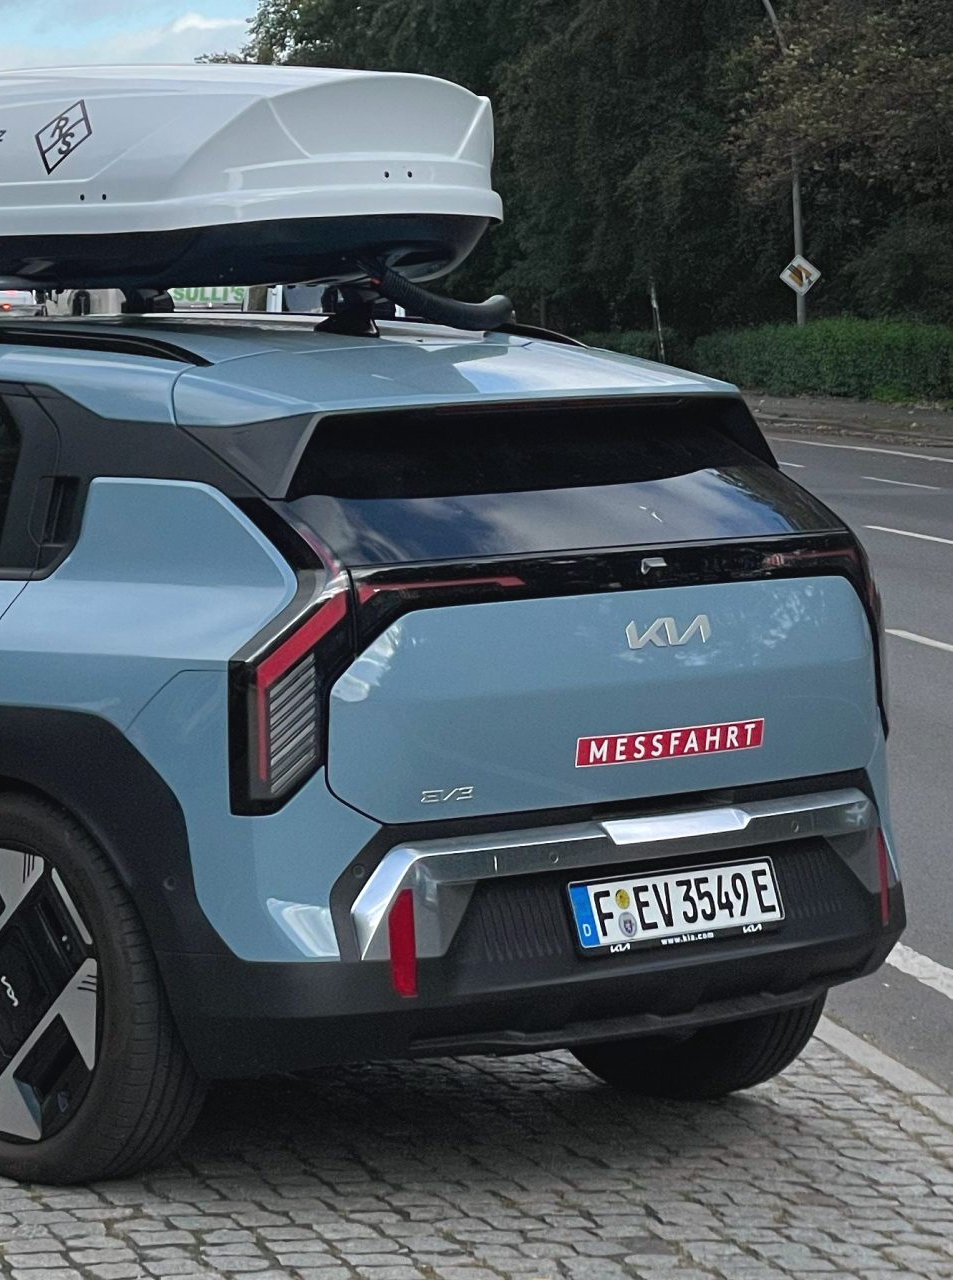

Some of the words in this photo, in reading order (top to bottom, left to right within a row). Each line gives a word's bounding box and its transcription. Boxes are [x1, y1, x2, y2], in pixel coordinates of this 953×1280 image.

[589, 723, 756, 763] MESSFAHRT
[582, 924, 592, 937] D
[661, 931, 714, 945] www.kia.com
